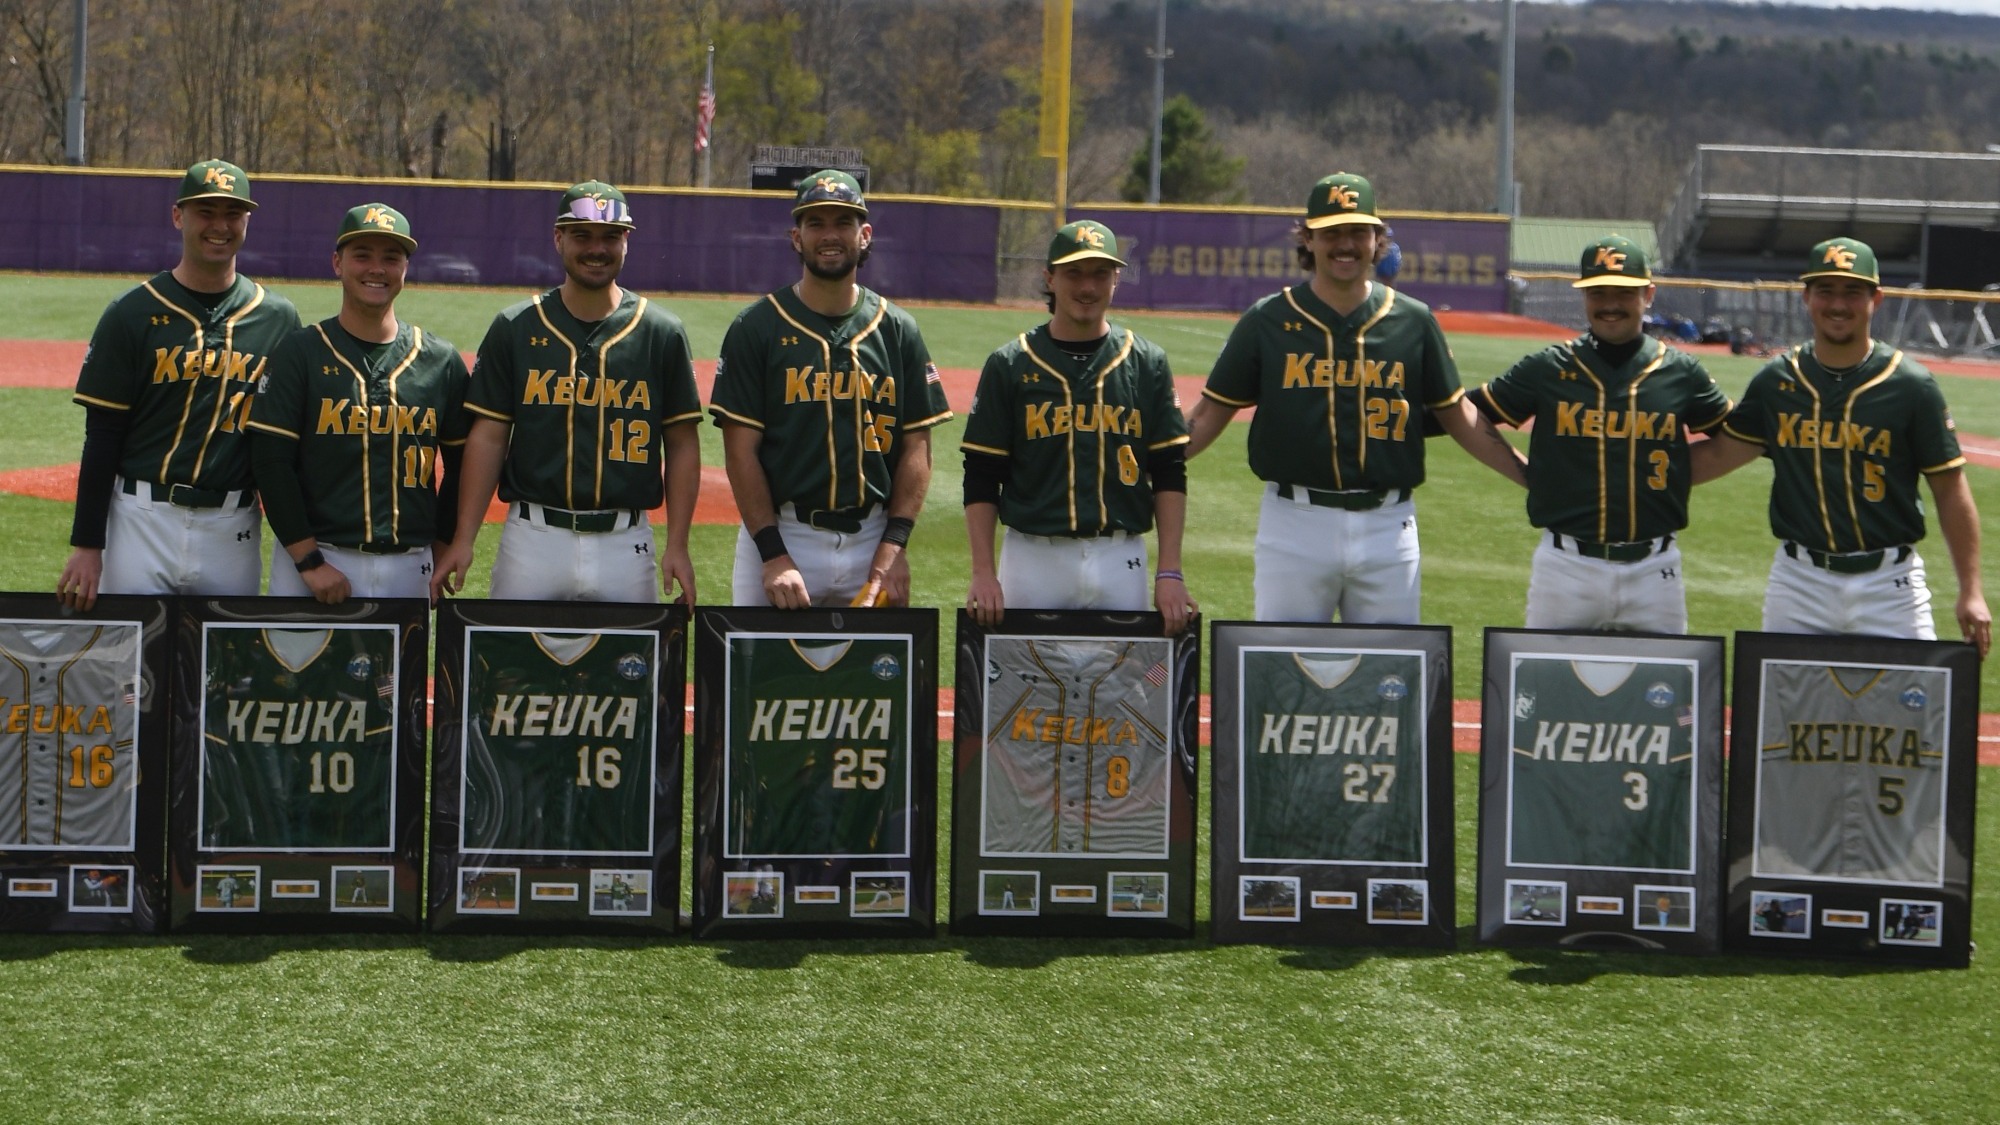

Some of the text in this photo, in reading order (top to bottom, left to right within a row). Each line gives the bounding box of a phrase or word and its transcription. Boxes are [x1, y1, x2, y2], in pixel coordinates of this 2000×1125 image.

[203, 167, 236, 192] KC
[1327, 184, 1360, 209] KC
[363, 207, 396, 231] KC
[1074, 226, 1105, 249] KC
[1594, 247, 1627, 271] KC
[1822, 245, 1857, 270] KC
[522, 369, 651, 410] KEUKA
[784, 365, 896, 406] KEUKA
[1282, 353, 1405, 391] KEUKA
[315, 397, 437, 436] KEUKA
[1025, 401, 1143, 440] KEUKA
[1366, 397, 1410, 442] 27
[1556, 400, 1677, 441] KEUKA
[1777, 412, 1892, 458] KEUKA
[608, 418, 651, 464] 12
[1647, 449, 1670, 491] 3
[1862, 460, 1886, 503] 5
[0, 696, 113, 735] EUKA
[227, 699, 367, 744] KEUKA
[489, 694, 638, 739] KEUKA
[749, 698, 892, 742] KEUKA
[1009, 706, 1140, 746] KEUKA
[1259, 714, 1399, 756] KEUKA
[1533, 721, 1671, 765] KEUKA
[1789, 721, 1922, 768] KEUKA
[68, 744, 115, 788] 16
[309, 751, 355, 793] 10
[576, 745, 622, 789] 16
[832, 748, 888, 790] 25
[1106, 755, 1131, 798] 8
[1343, 763, 1396, 803] 27
[1622, 771, 1648, 811] 3
[1878, 774, 1906, 817] 5
